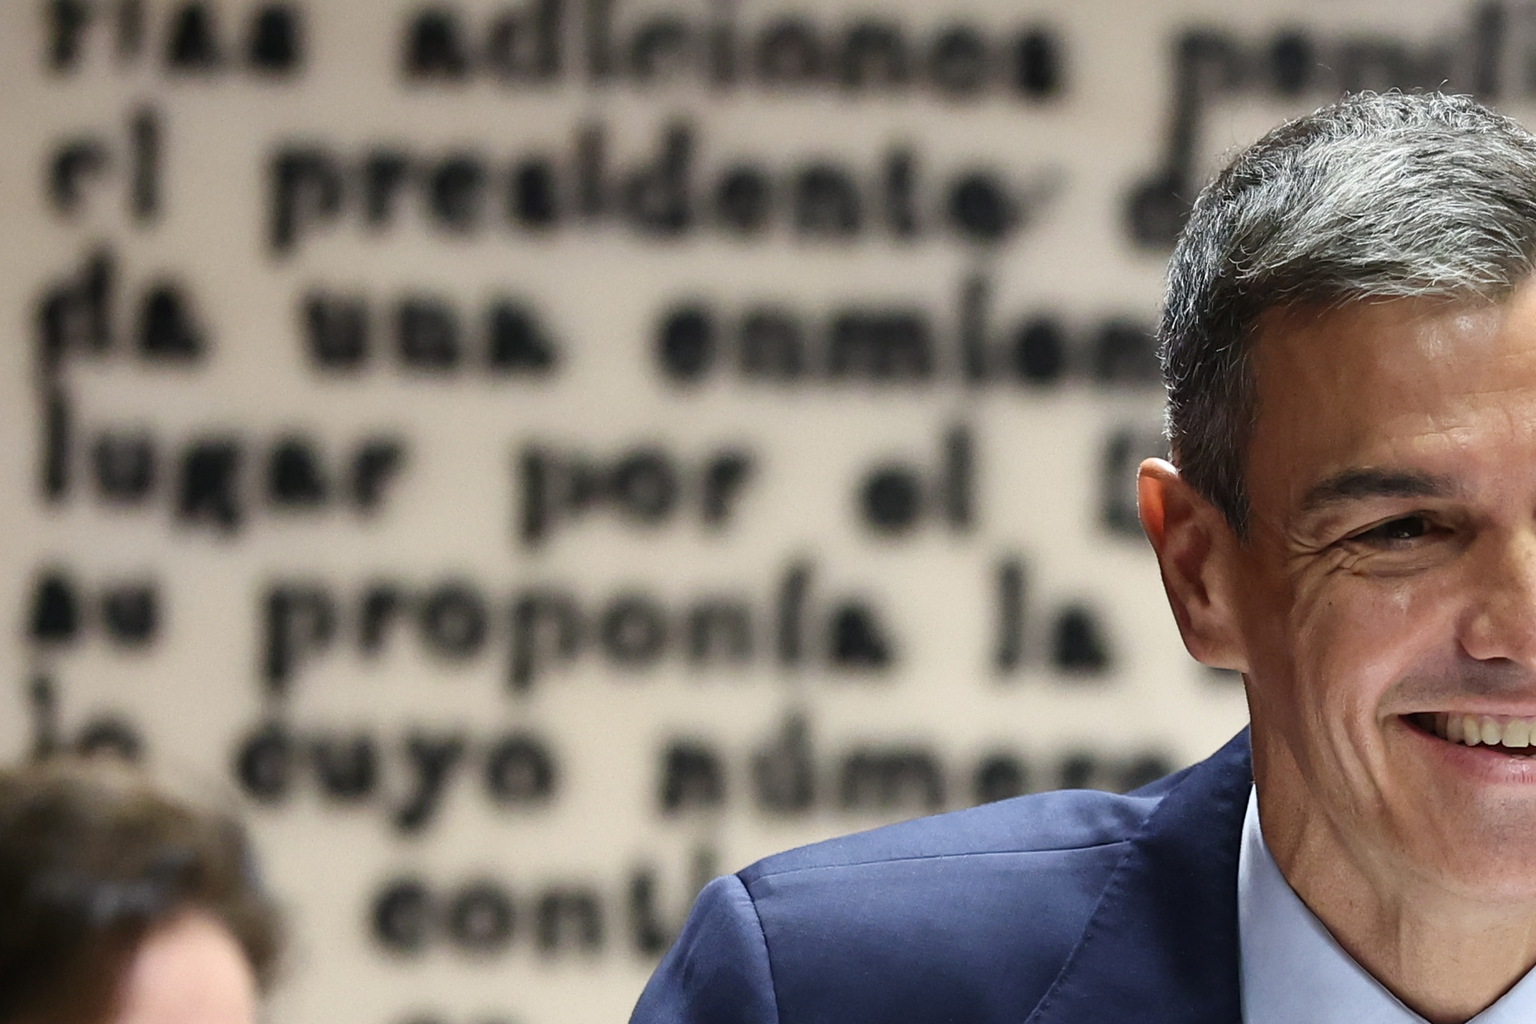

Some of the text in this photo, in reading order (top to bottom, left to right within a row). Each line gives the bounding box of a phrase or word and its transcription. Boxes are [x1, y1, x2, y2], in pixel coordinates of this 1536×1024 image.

[262, 116, 1022, 261] presidente
[299, 291, 559, 375] una
[33, 385, 407, 538] lugar
[513, 442, 757, 550] por
[992, 557, 1117, 680] la
[230, 715, 560, 835] cuyo
